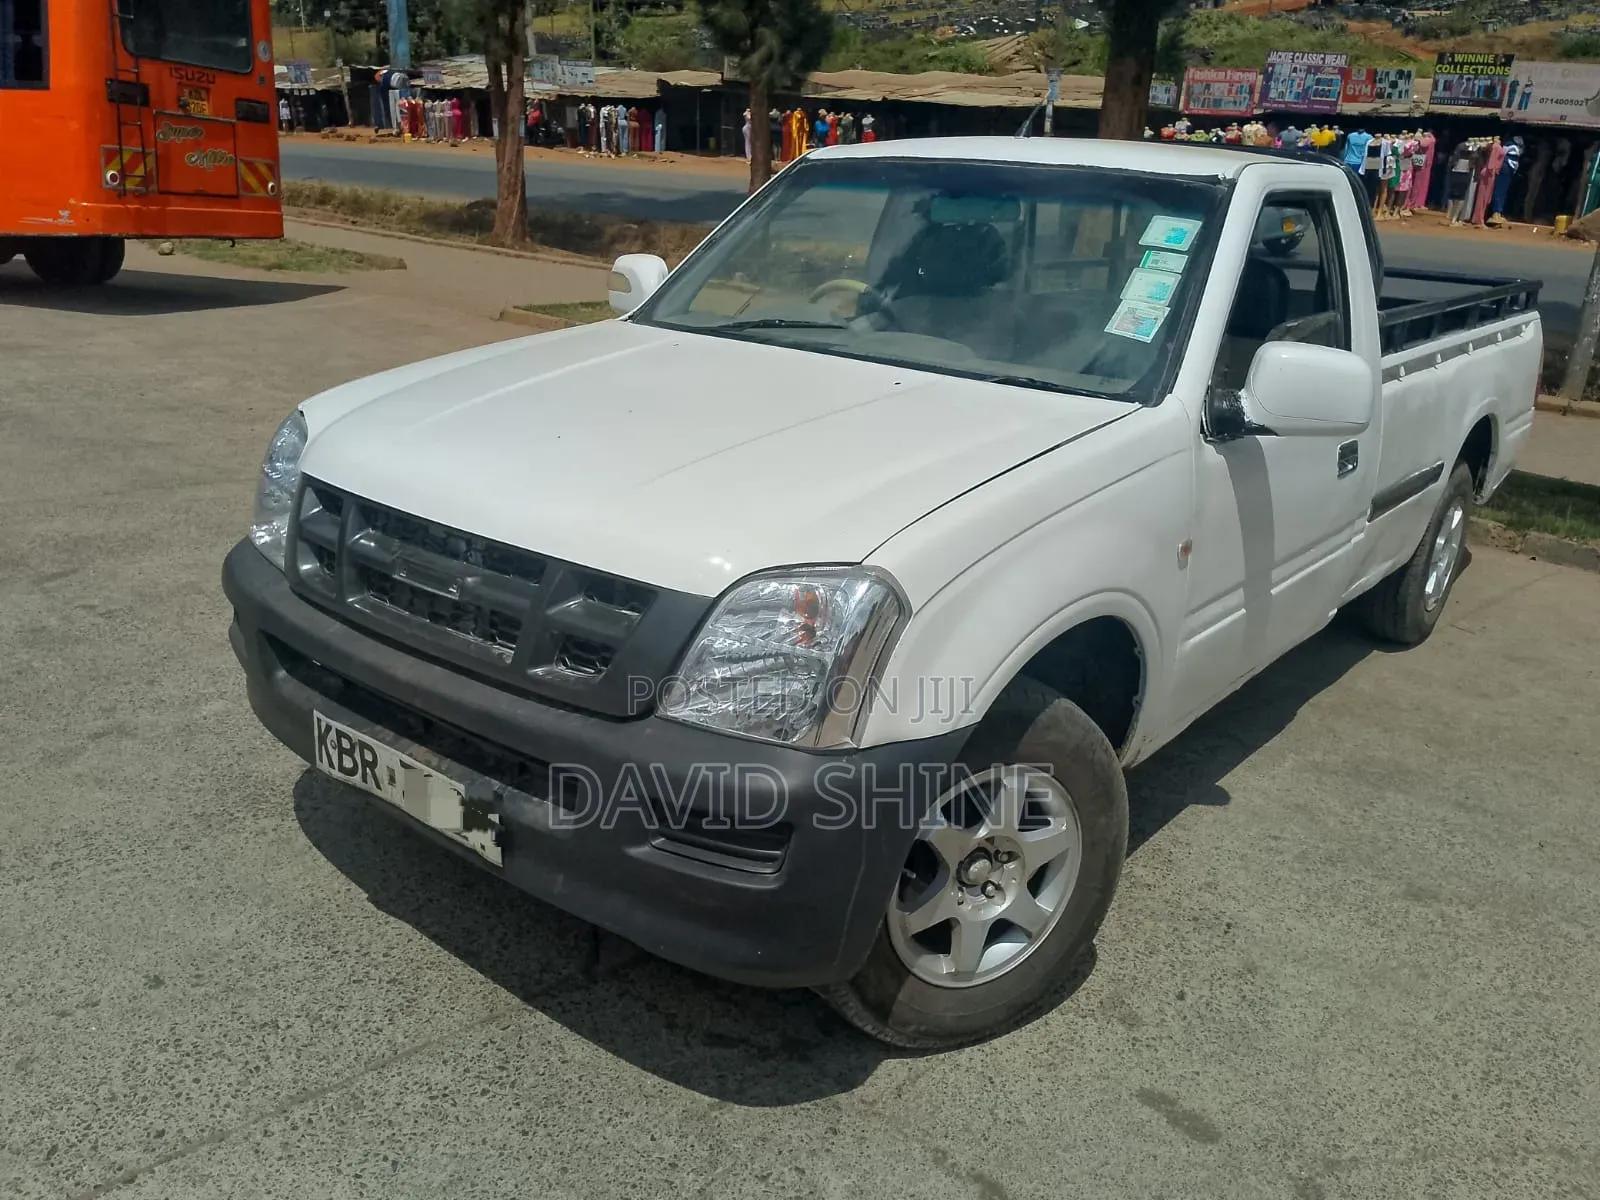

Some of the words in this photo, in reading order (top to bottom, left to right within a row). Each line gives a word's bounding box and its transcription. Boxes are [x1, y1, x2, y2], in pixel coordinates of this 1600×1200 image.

[1268, 51, 1293, 63] JACKIE
[1294, 52, 1324, 65] CLASSIC
[1325, 54, 1346, 66] WEAR
[1454, 54, 1495, 63] WINNIE
[170, 66, 216, 84] ISUZU
[1435, 64, 1510, 76] COLLECTIONS
[1346, 83, 1371, 95] GYM
[317, 718, 382, 791] KBR
